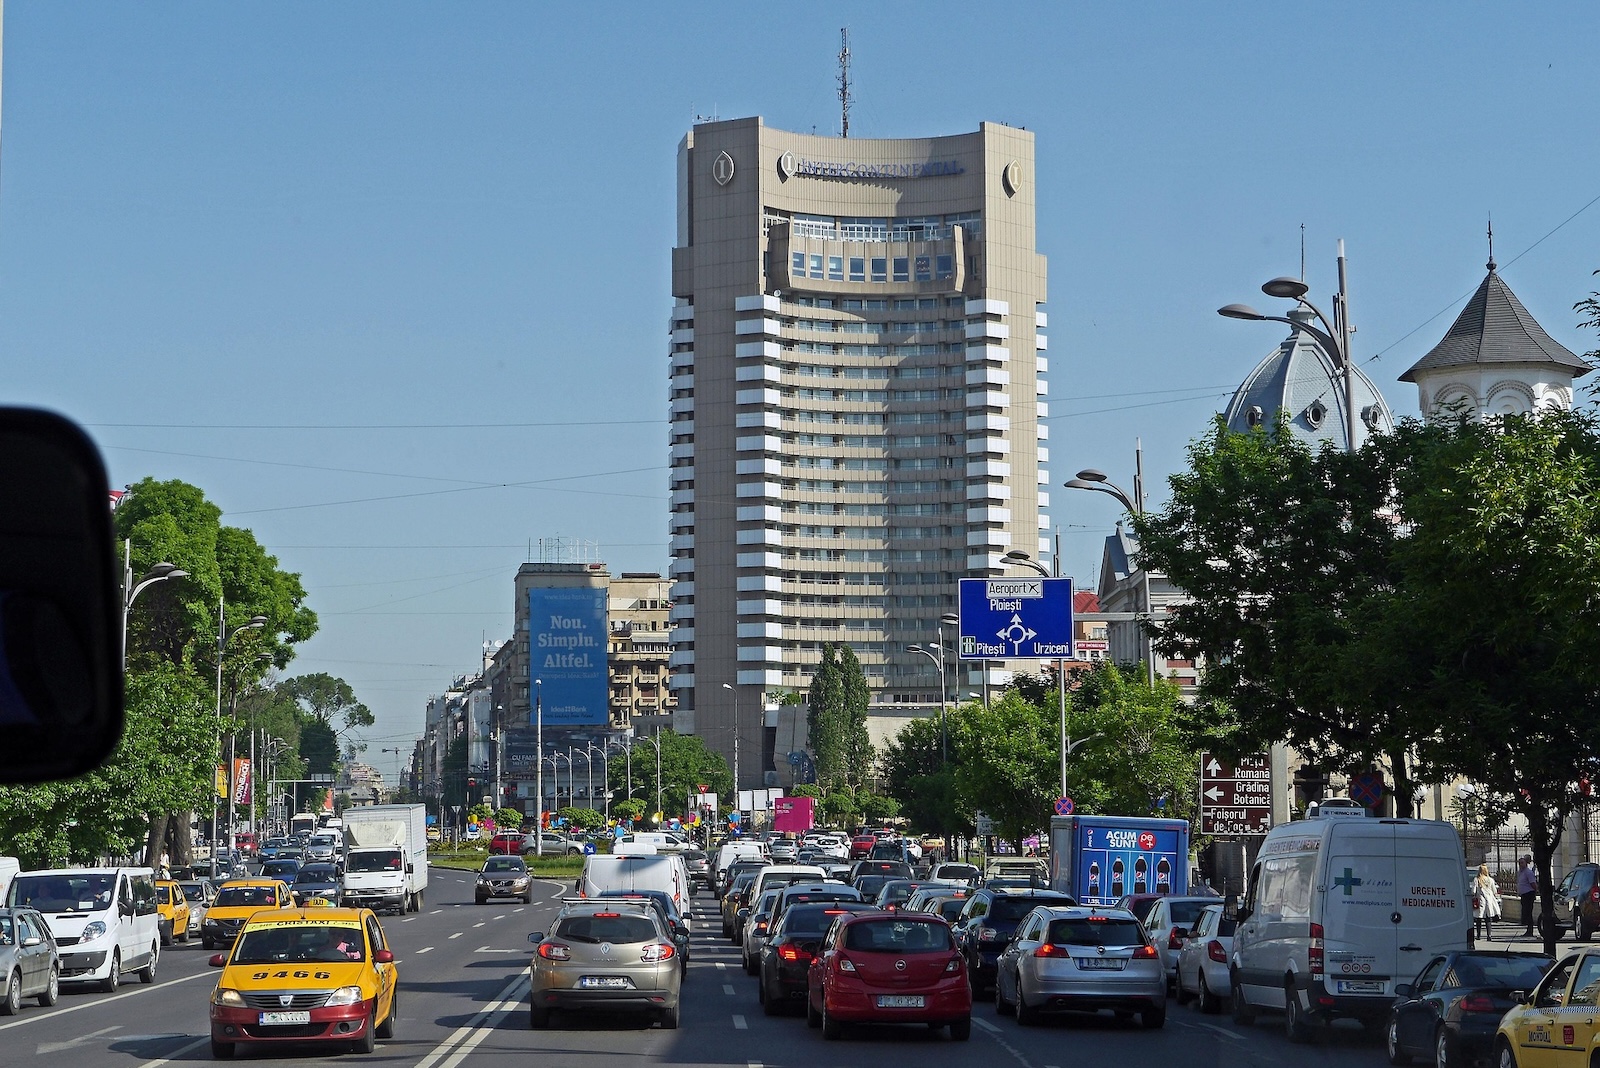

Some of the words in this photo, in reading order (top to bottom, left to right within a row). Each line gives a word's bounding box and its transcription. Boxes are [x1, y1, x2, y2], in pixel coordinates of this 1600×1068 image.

[800, 157, 964, 178] INTERCONTINENTAL
[989, 582, 1027, 597] Aeroport
[990, 599, 1022, 613] Ploiești
[550, 615, 587, 630] Nou.
[538, 632, 599, 650] Simplu.
[976, 642, 1006, 657] Pitești
[1033, 642, 1069, 655] Urziceni
[543, 653, 594, 668] Altfel.
[1234, 767, 1270, 779] Romană
[235, 763, 250, 804] HORNBACH
[1235, 781, 1270, 793] Grădina
[1210, 808, 1247, 821] Foișorul
[1106, 830, 1137, 841] ACUM
[1141, 834, 1153, 842] pe
[1110, 840, 1137, 848] SUNT
[1341, 899, 1393, 907] www.mediplus.com
[1401, 897, 1456, 909] MEDICAMENTE
[251, 970, 331, 980] 9466
[1528, 1030, 1552, 1043] MONDIAL
